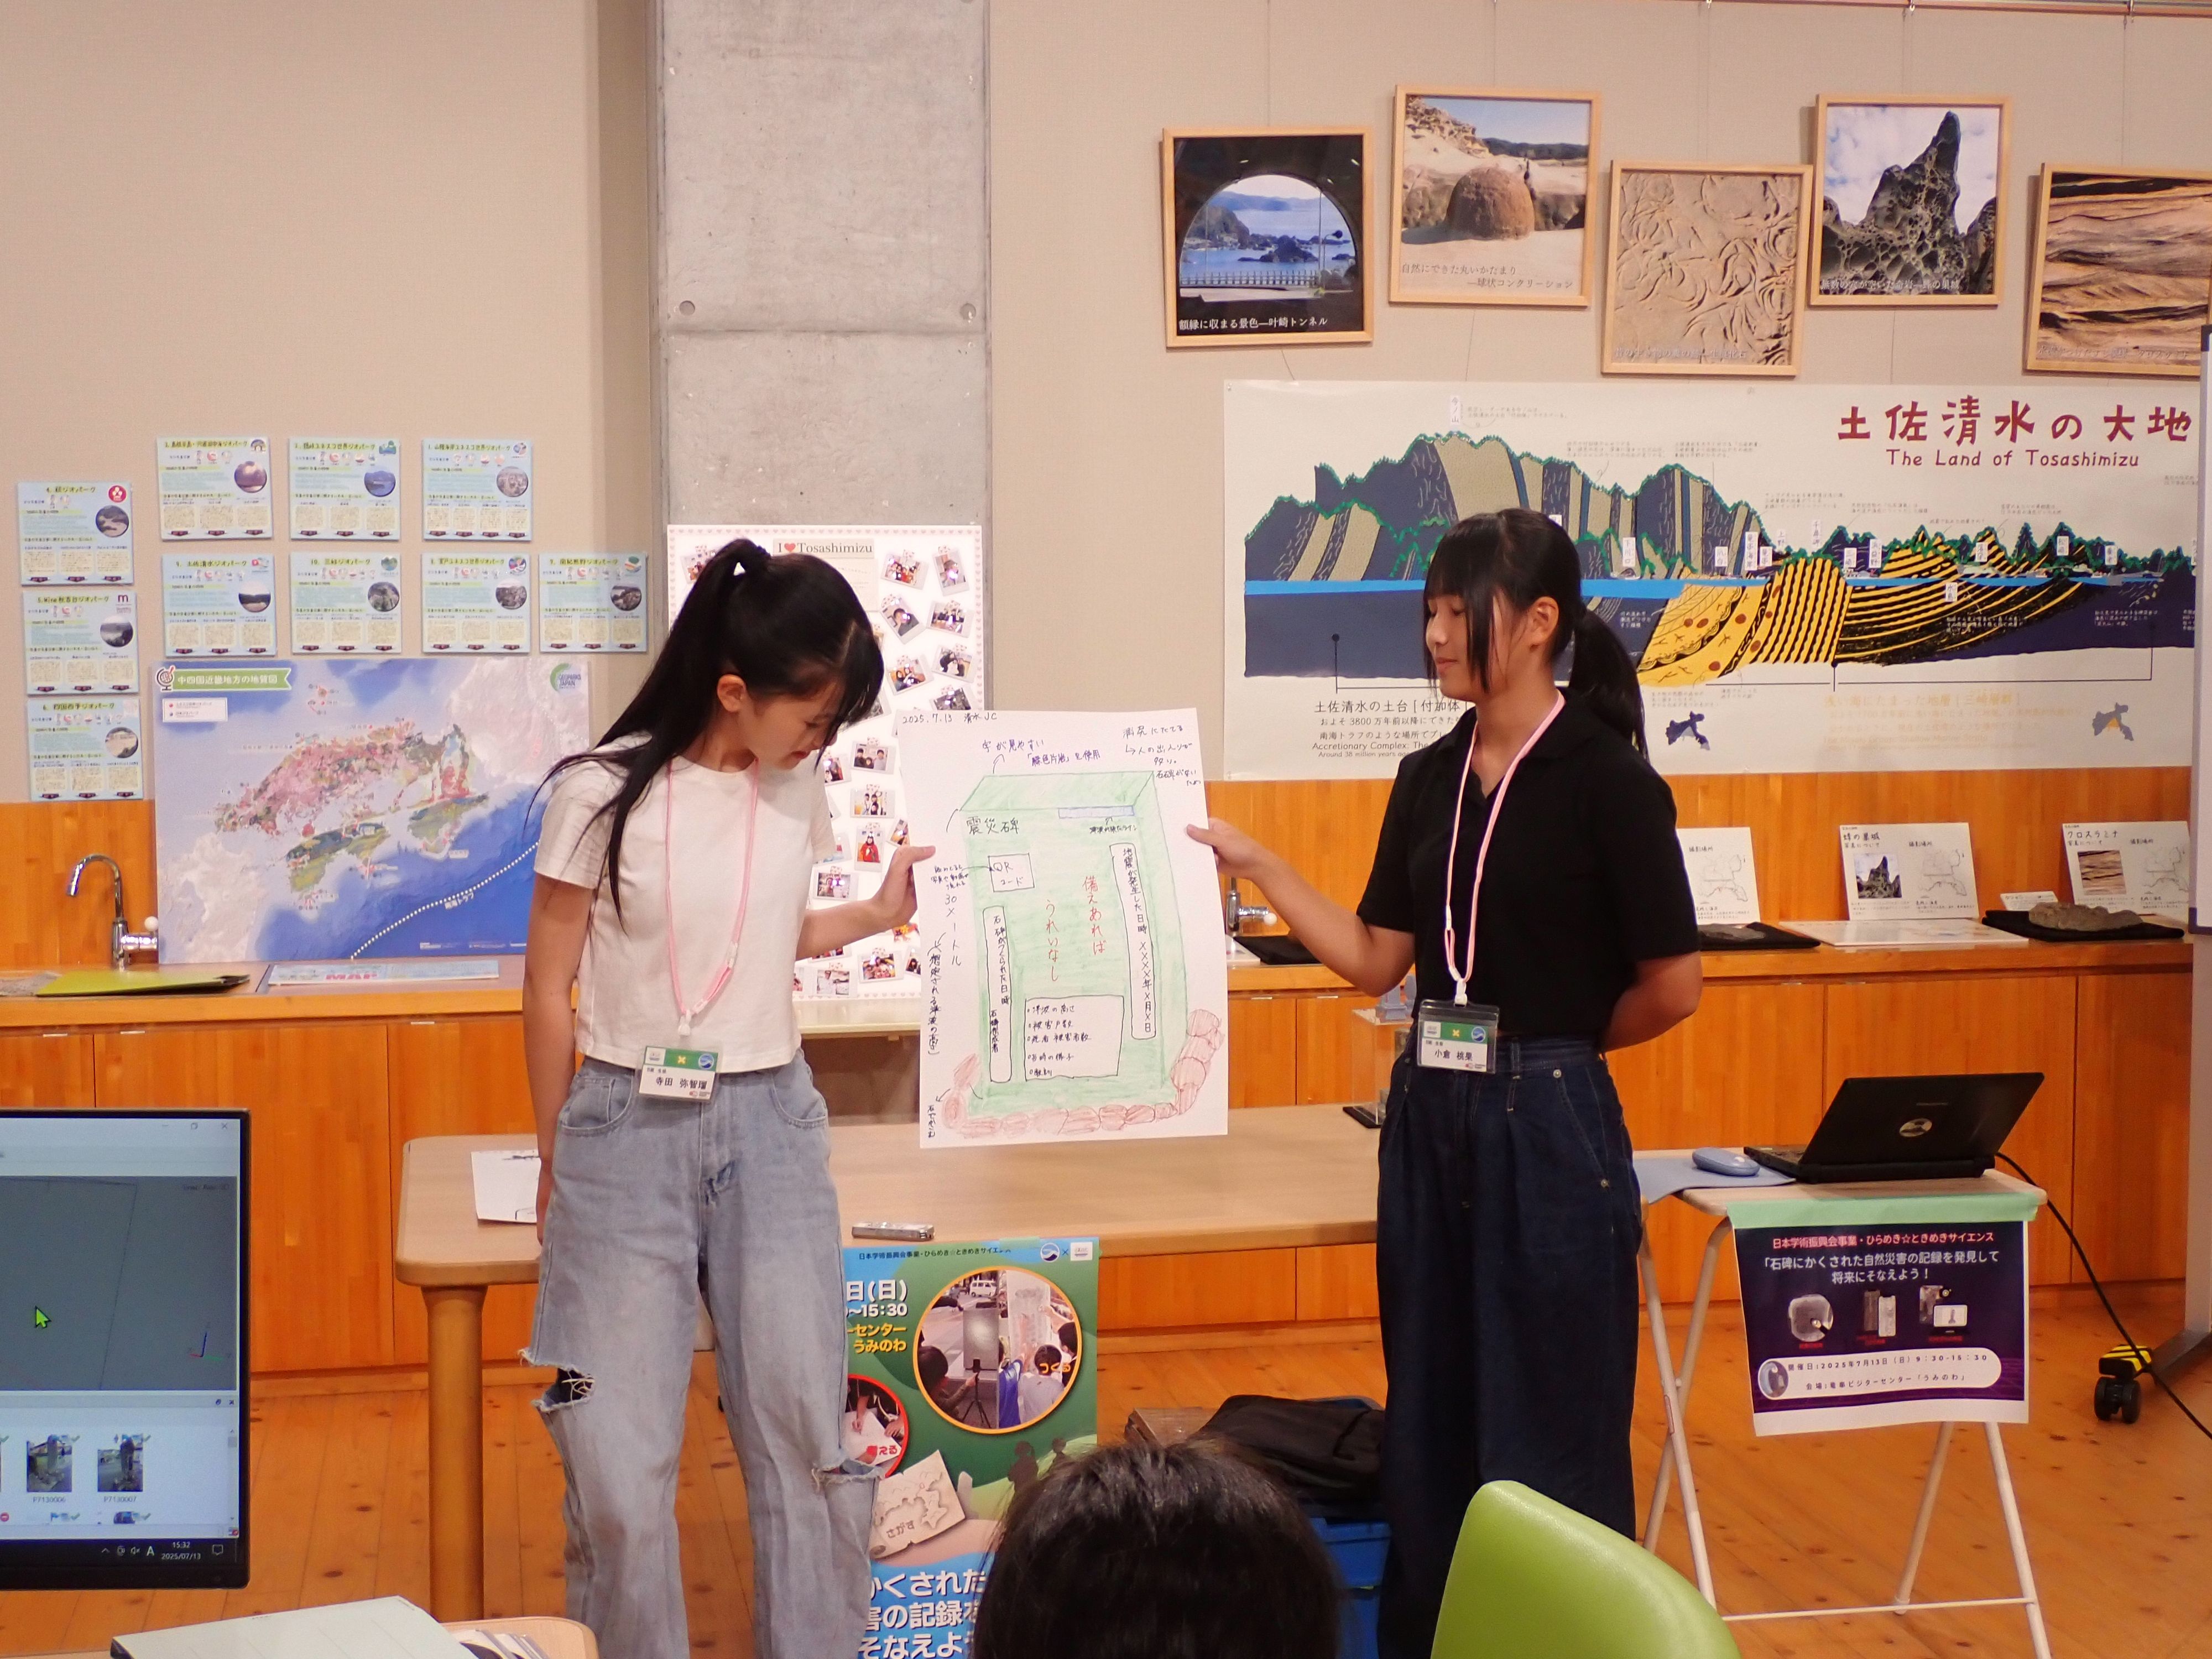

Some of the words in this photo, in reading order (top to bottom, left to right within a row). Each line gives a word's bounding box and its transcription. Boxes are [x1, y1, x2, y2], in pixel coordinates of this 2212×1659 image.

[1401, 263, 1517, 276] 自然にできた丸いかたまり
[1838, 395, 2192, 446] 土佐清水の大地
[1886, 448, 1922, 466] The
[1936, 448, 1981, 466] Land
[1993, 450, 2013, 466] of
[2026, 449, 2139, 467] Tosashimizu
[778, 543, 782, 552] I
[797, 542, 873, 553] Tosashimizu
[178, 675, 278, 685] 中四国近畿地方の地質図
[902, 713, 952, 724] 2025.7.13
[982, 739, 1044, 753] 字が見やすい
[1312, 742, 1367, 751] Accretionary
[967, 816, 1019, 835] 震災碑
[2068, 830, 2119, 838] クロスラミナ
[994, 861, 1014, 873] QR
[1000, 877, 1024, 886] コード
[1083, 875, 1107, 956] 備えあれば
[1046, 900, 1060, 982] うれいなし
[1773, 1232, 1994, 1249] 日本学術振興会事業・ひらめき☆ときめきサイエンス
[1764, 1250, 2000, 1271] 「石碑にかくされた自然災害の記録を発見して
[1831, 1268, 1929, 1284] 将来にそなえよう！
[853, 1338, 907, 1354] うみのわ
[1039, 1361, 1072, 1374] つくる
[886, 1520, 915, 1539] さがす
[147, 1546, 155, 1556] A
[161, 1553, 201, 1561] 2025/07/13
[858, 1631, 974, 1659] そなえよ
